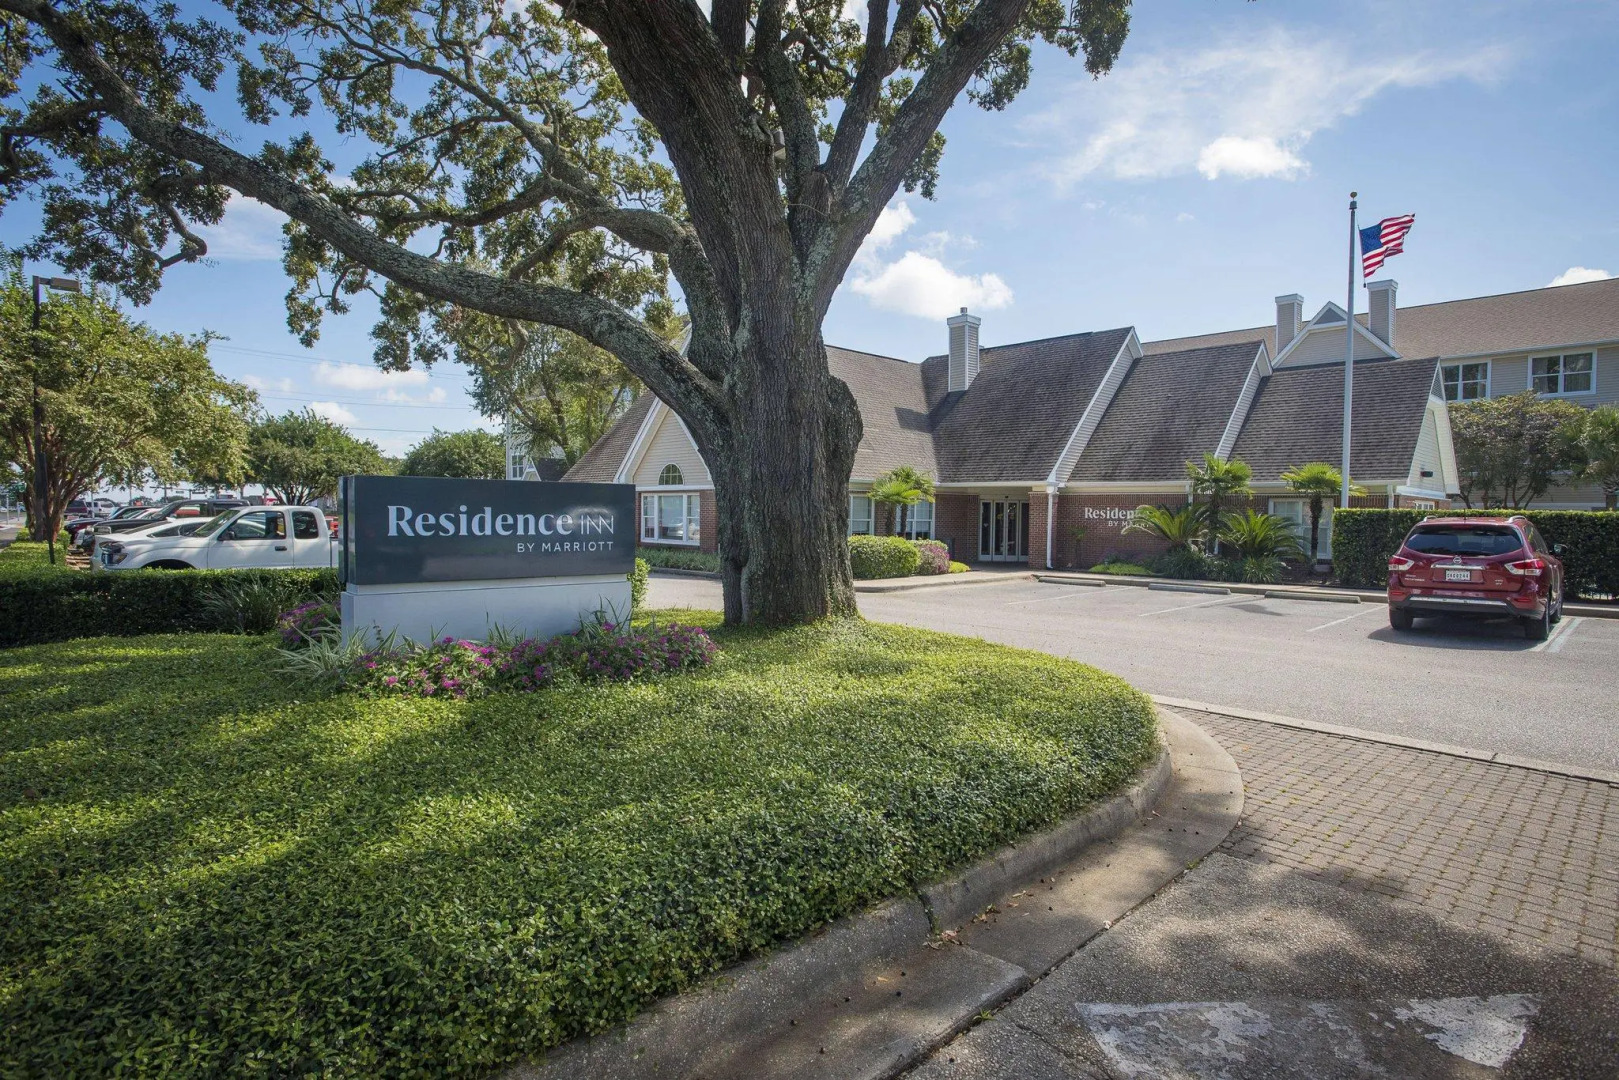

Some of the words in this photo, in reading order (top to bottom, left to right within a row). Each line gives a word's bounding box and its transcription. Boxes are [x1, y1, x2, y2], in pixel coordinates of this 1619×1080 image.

[1085, 507, 1134, 519] Residen
[387, 505, 573, 536] Residence
[580, 515, 614, 534] INN
[517, 542, 535, 553] BY
[541, 541, 614, 552] MARRIOTT
